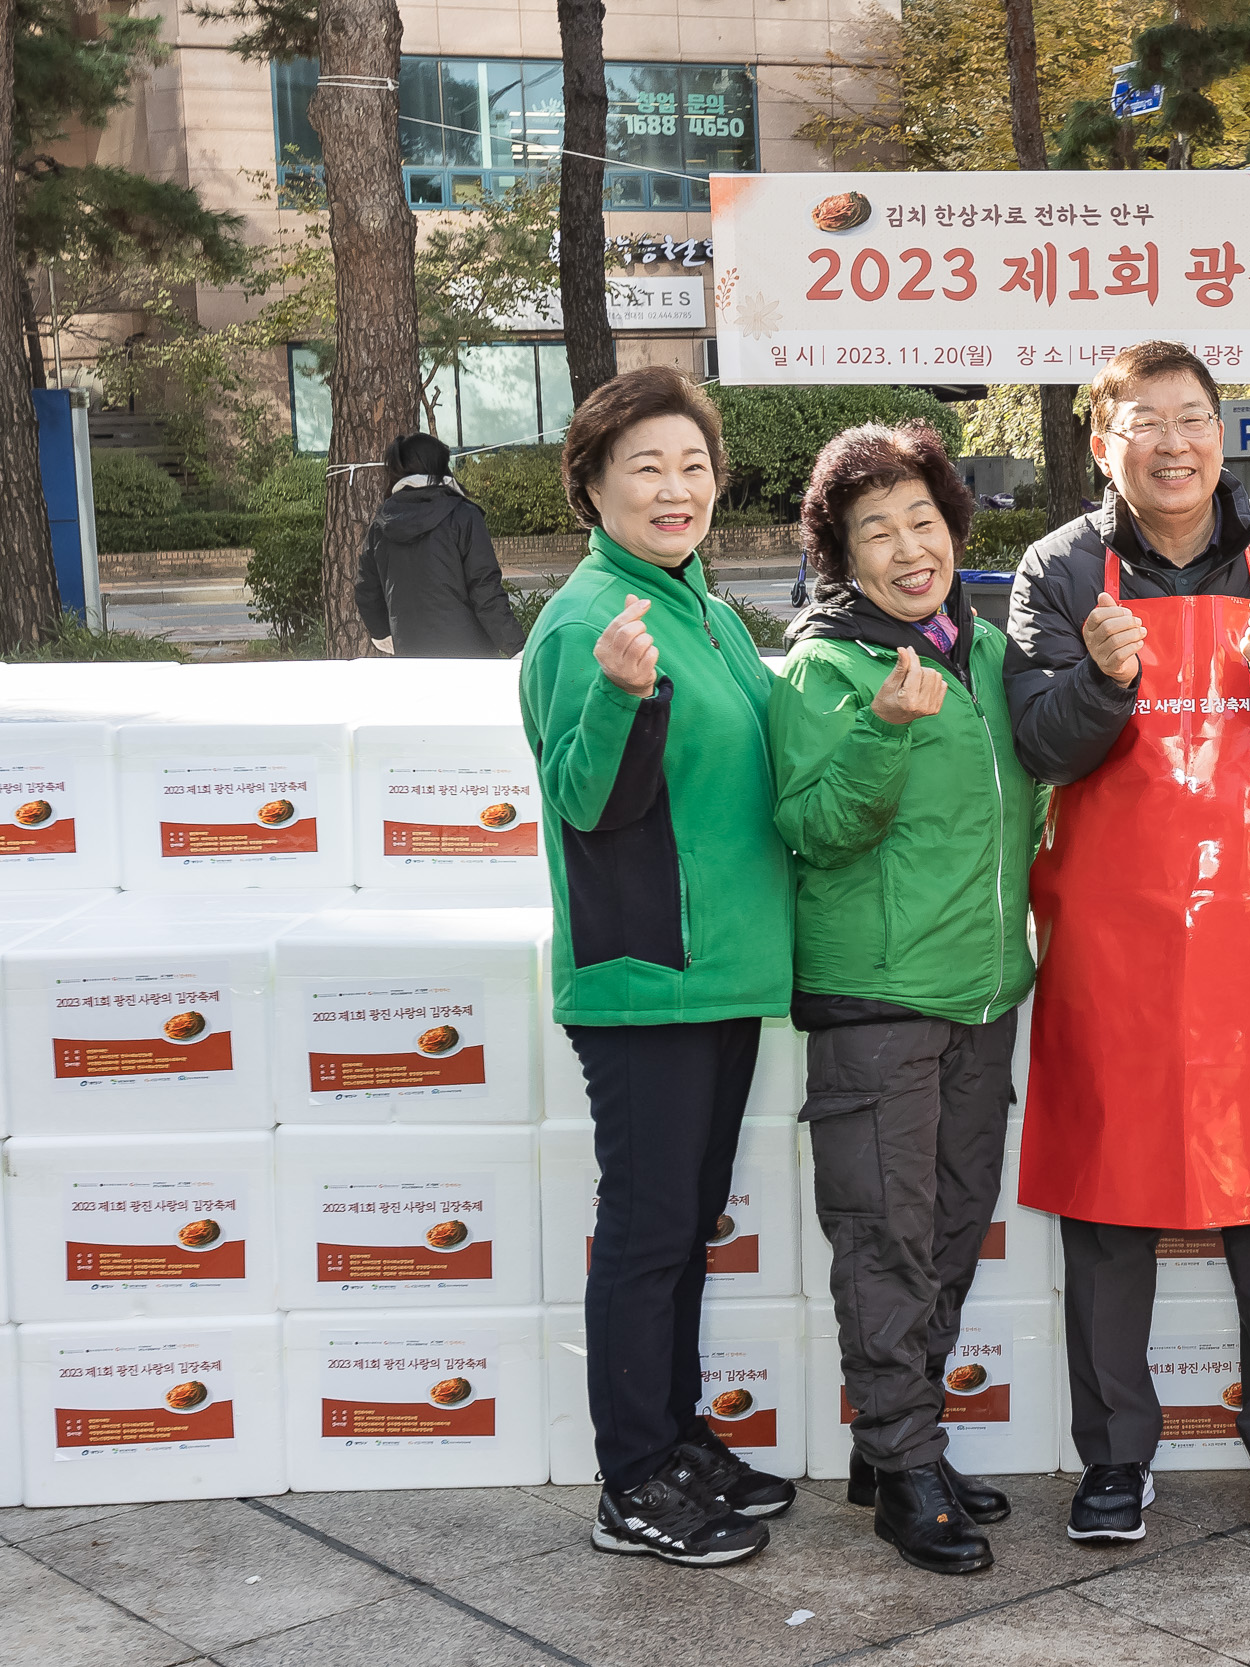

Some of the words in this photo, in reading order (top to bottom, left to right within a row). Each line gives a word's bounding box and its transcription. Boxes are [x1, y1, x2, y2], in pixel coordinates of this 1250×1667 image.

[637, 91, 676, 114] 창업
[687, 93, 724, 116] 문의
[624, 116, 676, 136] 1688
[688, 117, 745, 138] 4650
[886, 204, 927, 228] 김치
[935, 204, 1028, 228] 한상자로
[1034, 203, 1102, 226] 전하는
[1110, 203, 1154, 226] 안부
[806, 248, 978, 302] 2023
[999, 242, 1159, 307] 제1회
[610, 291, 691, 306] LATES
[770, 345, 788, 366] 일
[796, 345, 814, 366] 시
[836, 346, 892, 366] 2023.
[934, 346, 993, 367] 20(월)
[1017, 345, 1036, 366] 장
[1044, 346, 1064, 365] 소
[1203, 345, 1243, 366] 광장
[1154, 698, 1196, 714] 사랑의
[0, 783, 22, 794] 랑의
[163, 786, 185, 794] 2023
[186, 784, 211, 794] 제1회
[213, 784, 234, 794] 광진
[235, 783, 266, 793] 사랑의
[268, 781, 307, 792] 김장축제
[410, 785, 436, 795] 제1회
[437, 785, 458, 796] 광진
[459, 785, 489, 796] 사랑의
[491, 785, 530, 796] 김장축제
[55, 998, 81, 1007] 2023
[81, 996, 111, 1007] 제1회
[112, 995, 136, 1007] 광진
[137, 993, 172, 1005] 사랑의
[174, 991, 220, 1004] 김장축제
[312, 1012, 337, 1022] 2023
[337, 1010, 367, 1021] 제1회
[368, 1009, 391, 1021] 광진
[392, 1007, 427, 1019] 사랑의
[429, 1005, 473, 1018] 김장축제
[71, 1202, 97, 1211] 2023
[97, 1201, 127, 1212] 제1회
[129, 1201, 153, 1212] 광진
[153, 1200, 189, 1212] 사랑의
[191, 1200, 236, 1211] 김장축제
[322, 1204, 347, 1212] 2023
[347, 1202, 376, 1213] 제1회
[378, 1202, 401, 1214] 광진
[402, 1201, 436, 1213] 사랑의
[439, 1200, 483, 1213] 김장축제
[960, 1345, 1002, 1356] 김장축제
[58, 1368, 84, 1377] 2023
[84, 1366, 113, 1378] 제1회
[116, 1365, 139, 1377] 광진
[140, 1363, 175, 1375] 사랑의
[177, 1360, 222, 1374] 김장축제
[327, 1360, 352, 1368] 2023
[352, 1359, 381, 1370] 제1회
[383, 1359, 406, 1370] 광진
[407, 1358, 441, 1370] 사랑의
[443, 1358, 487, 1370] 김장축제
[1148, 1363, 1174, 1375] 제1회
[1177, 1362, 1198, 1374] 광진
[1200, 1361, 1232, 1373] 사랑의
[700, 1370, 722, 1382] 랑의
[725, 1369, 768, 1382] 김장축제
